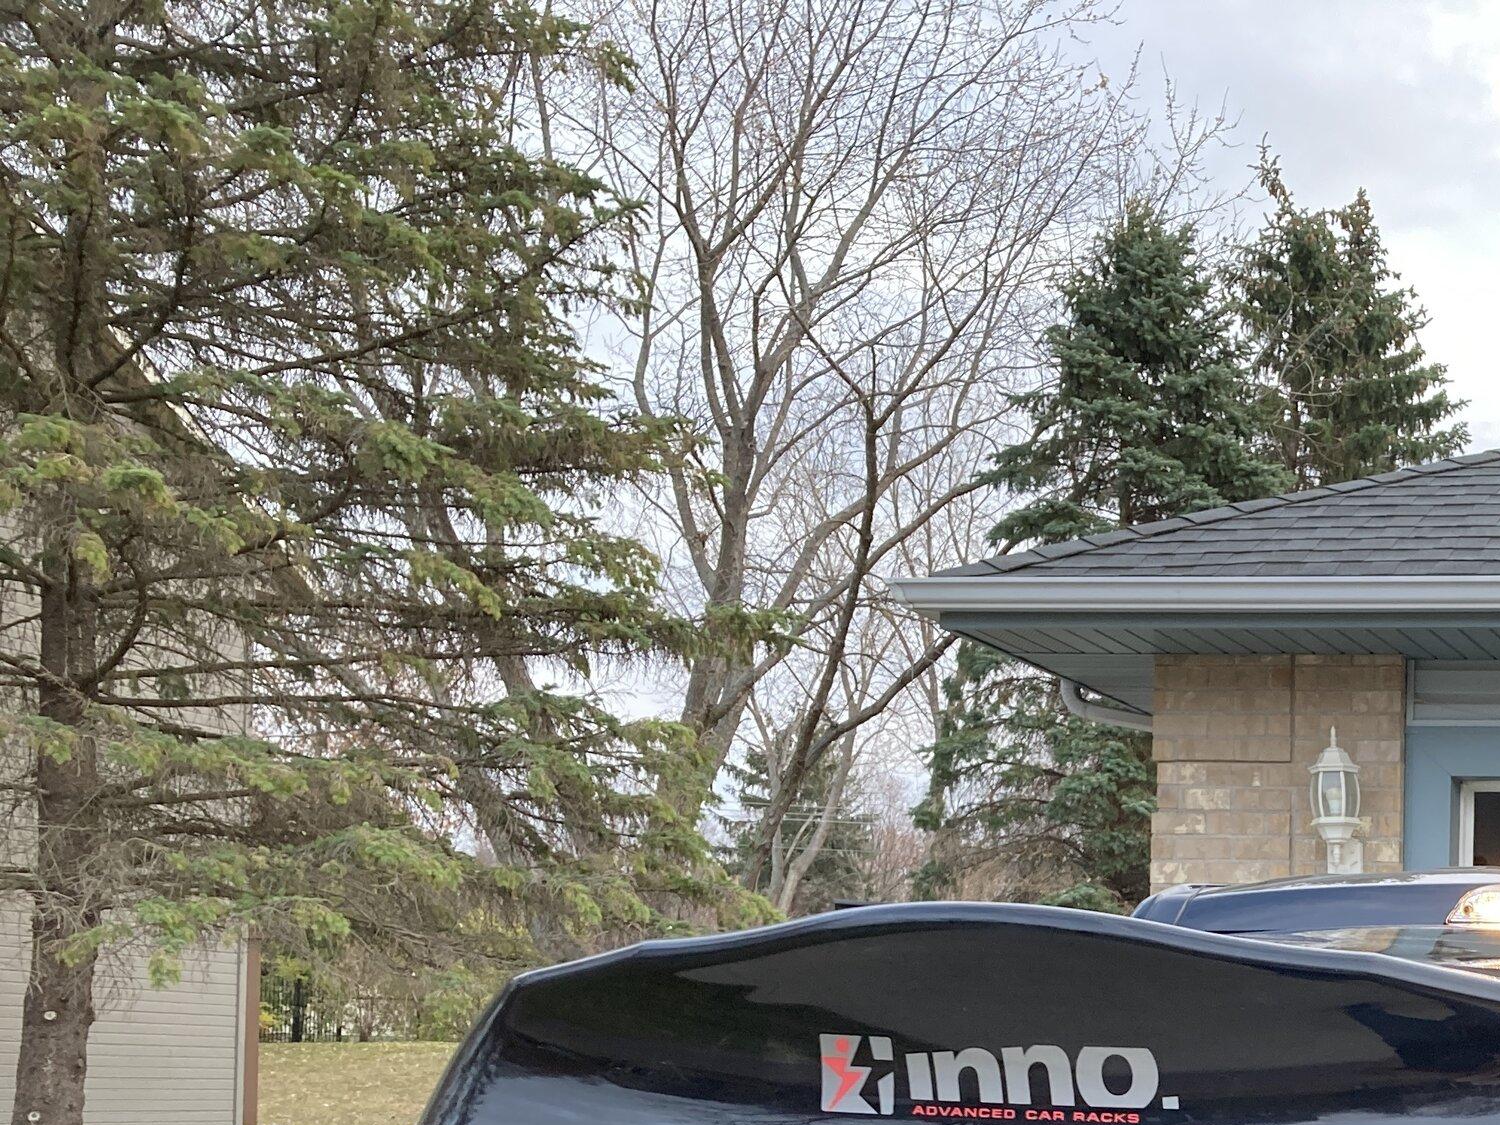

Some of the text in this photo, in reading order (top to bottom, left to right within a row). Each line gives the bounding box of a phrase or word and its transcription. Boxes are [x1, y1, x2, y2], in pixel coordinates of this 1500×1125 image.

[911, 1104, 1141, 1124] ADVANCED CAR RACKS
